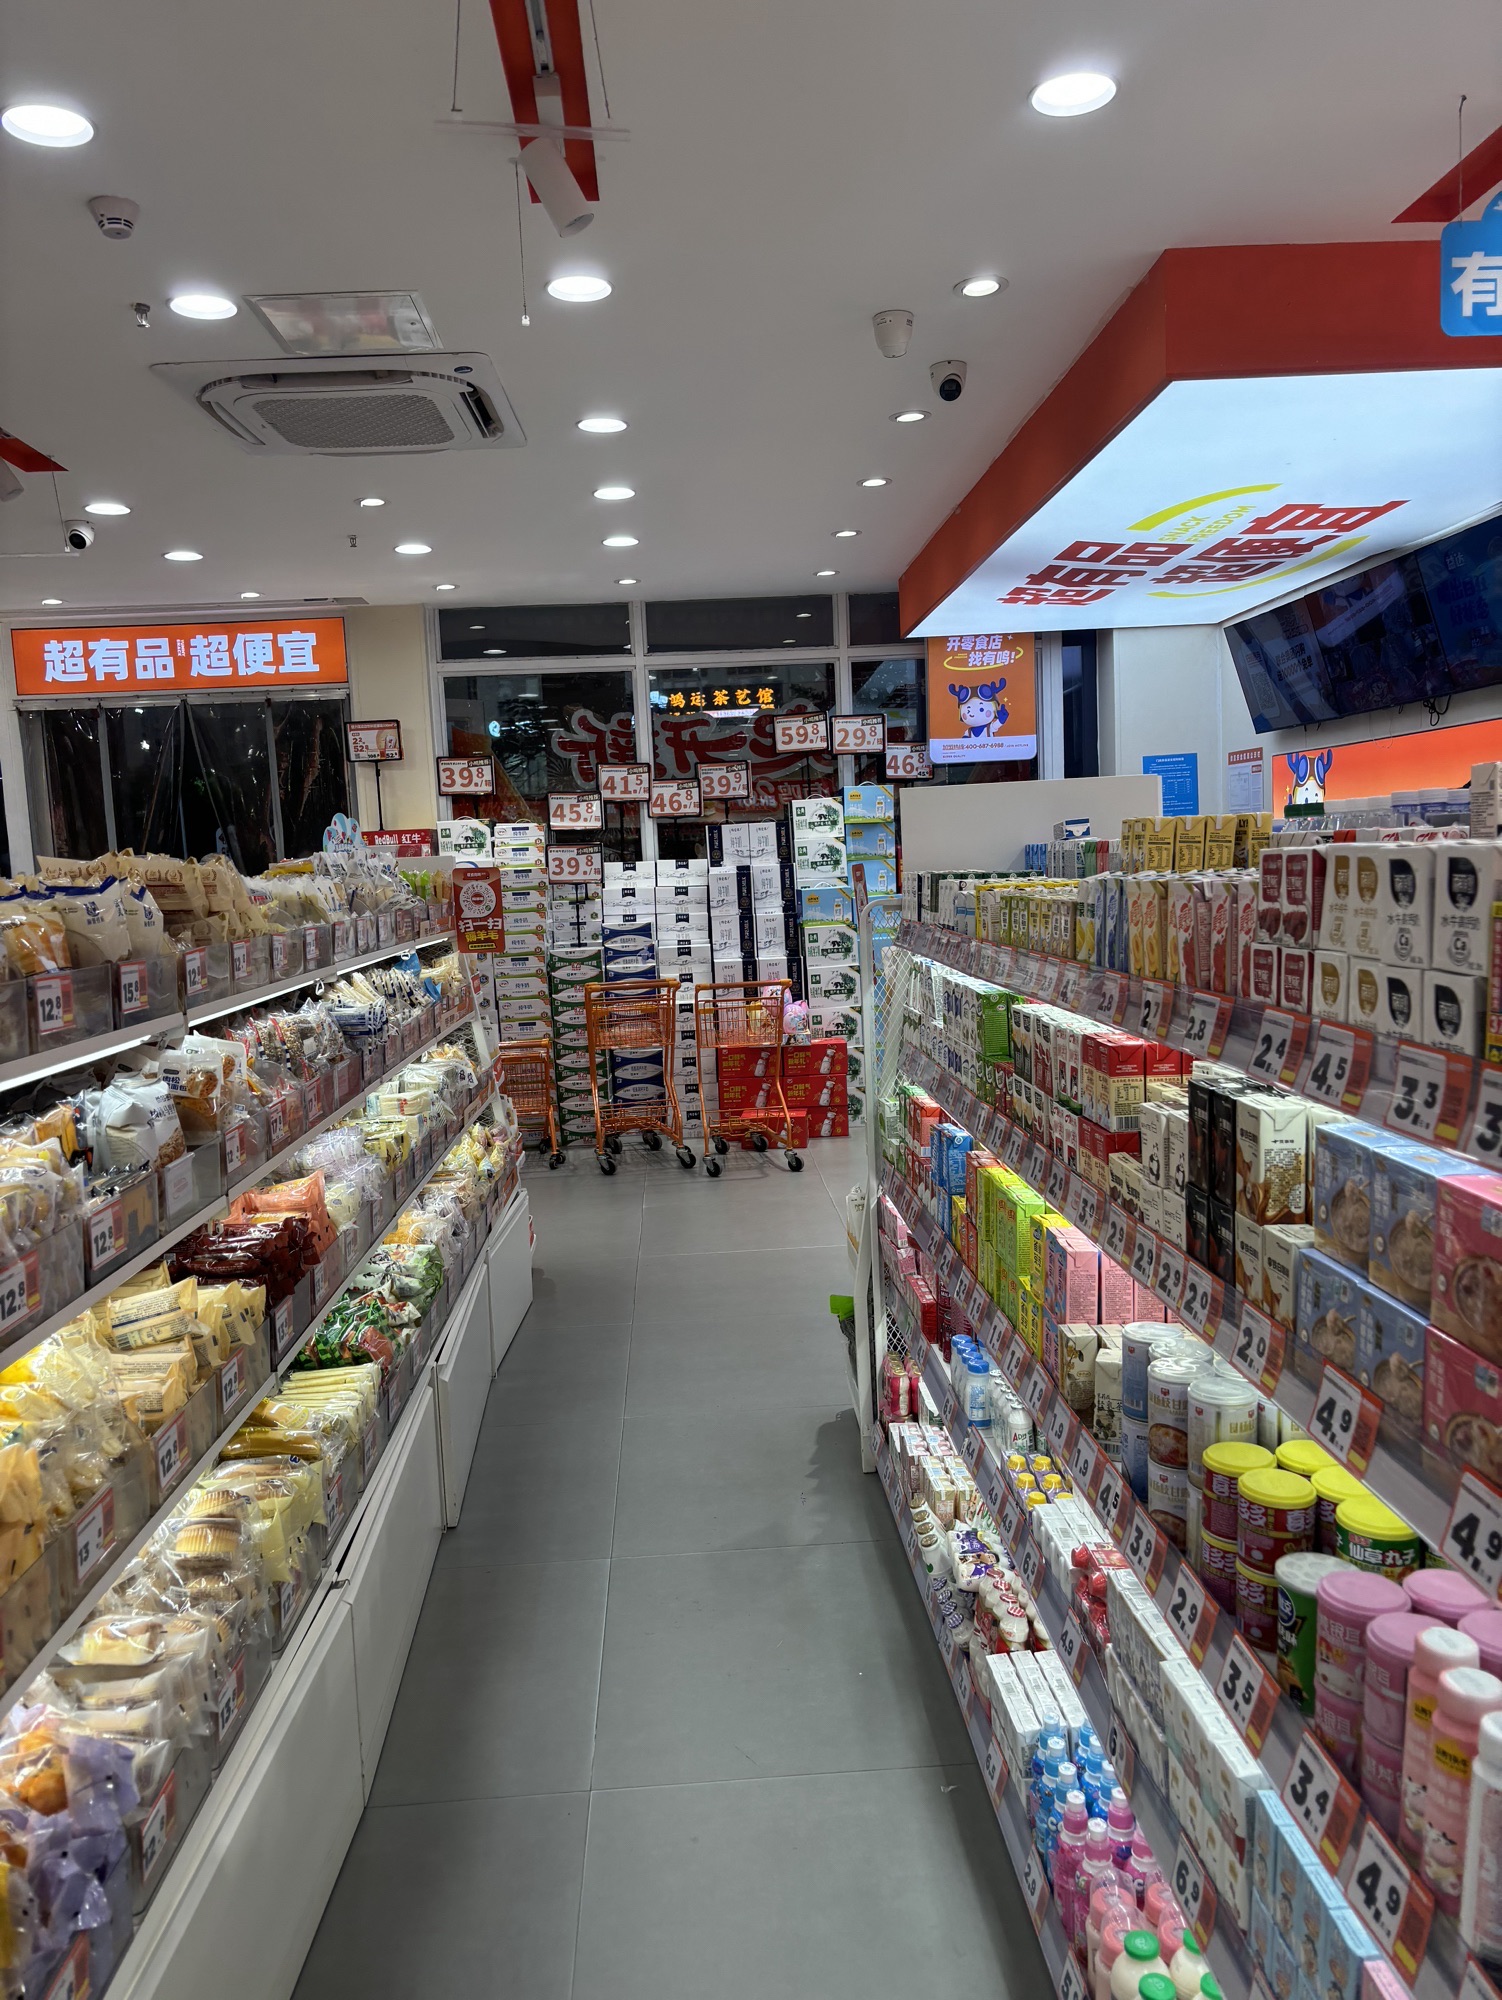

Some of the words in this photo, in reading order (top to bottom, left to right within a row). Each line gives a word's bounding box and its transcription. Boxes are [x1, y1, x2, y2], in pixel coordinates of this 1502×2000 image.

[1149, 499, 1412, 585] 超便宜
[1158, 515, 1211, 542] SNACK
[1184, 505, 1257, 543] FREEDOM
[996, 540, 1195, 606] 超有品
[44, 637, 175, 683] 超有品
[190, 630, 320, 678] 超便宜
[946, 635, 1003, 652] 开零食店
[669, 688, 774, 709] 鸿运茶艺馆
[374, 833, 399, 845] RedBull
[401, 832, 421, 844] 红牛
[458, 918, 502, 933] 扫一扫
[39, 996, 62, 1022] 12.8
[1186, 1017, 1206, 1041] 2.8
[1252, 1034, 1288, 1073] 2.4
[1310, 1053, 1348, 1096] 4.5
[1394, 1075, 1439, 1125] 3.3
[93, 1225, 114, 1258] 12.8
[1106, 1220, 1125, 1253] 2.9
[1134, 1243, 1154, 1279] 2.9
[1159, 1263, 1181, 1301] 2.9
[1181, 1282, 1209, 1323] 2.0
[1236, 1326, 1267, 1373] 2.0
[1051, 1411, 1065, 1438] 1.9
[1315, 1397, 1353, 1443] 4.9
[966, 1440, 976, 1460] 4.4
[1074, 1450, 1090, 1476] 1.9
[988, 1486, 998, 1508] 4.9
[1098, 1483, 1121, 1519] 4.5
[1001, 1514, 1013, 1533] 4.9
[1129, 1526, 1152, 1565] 3.9
[1349, 1543, 1415, 1566] 仙草丸子
[1451, 1513, 1502, 1572] 4.9
[1022, 1559, 1037, 1587] 6.5
[1169, 1587, 1199, 1632] 2.9
[1060, 1634, 1075, 1656] 4.9
[1222, 1659, 1255, 1714] 3.5
[1290, 1759, 1330, 1821] 3.4
[1023, 1862, 1036, 1897] 2.9
[1175, 1860, 1201, 1911] 6.9
[1356, 1861, 1402, 1922] 4.9
